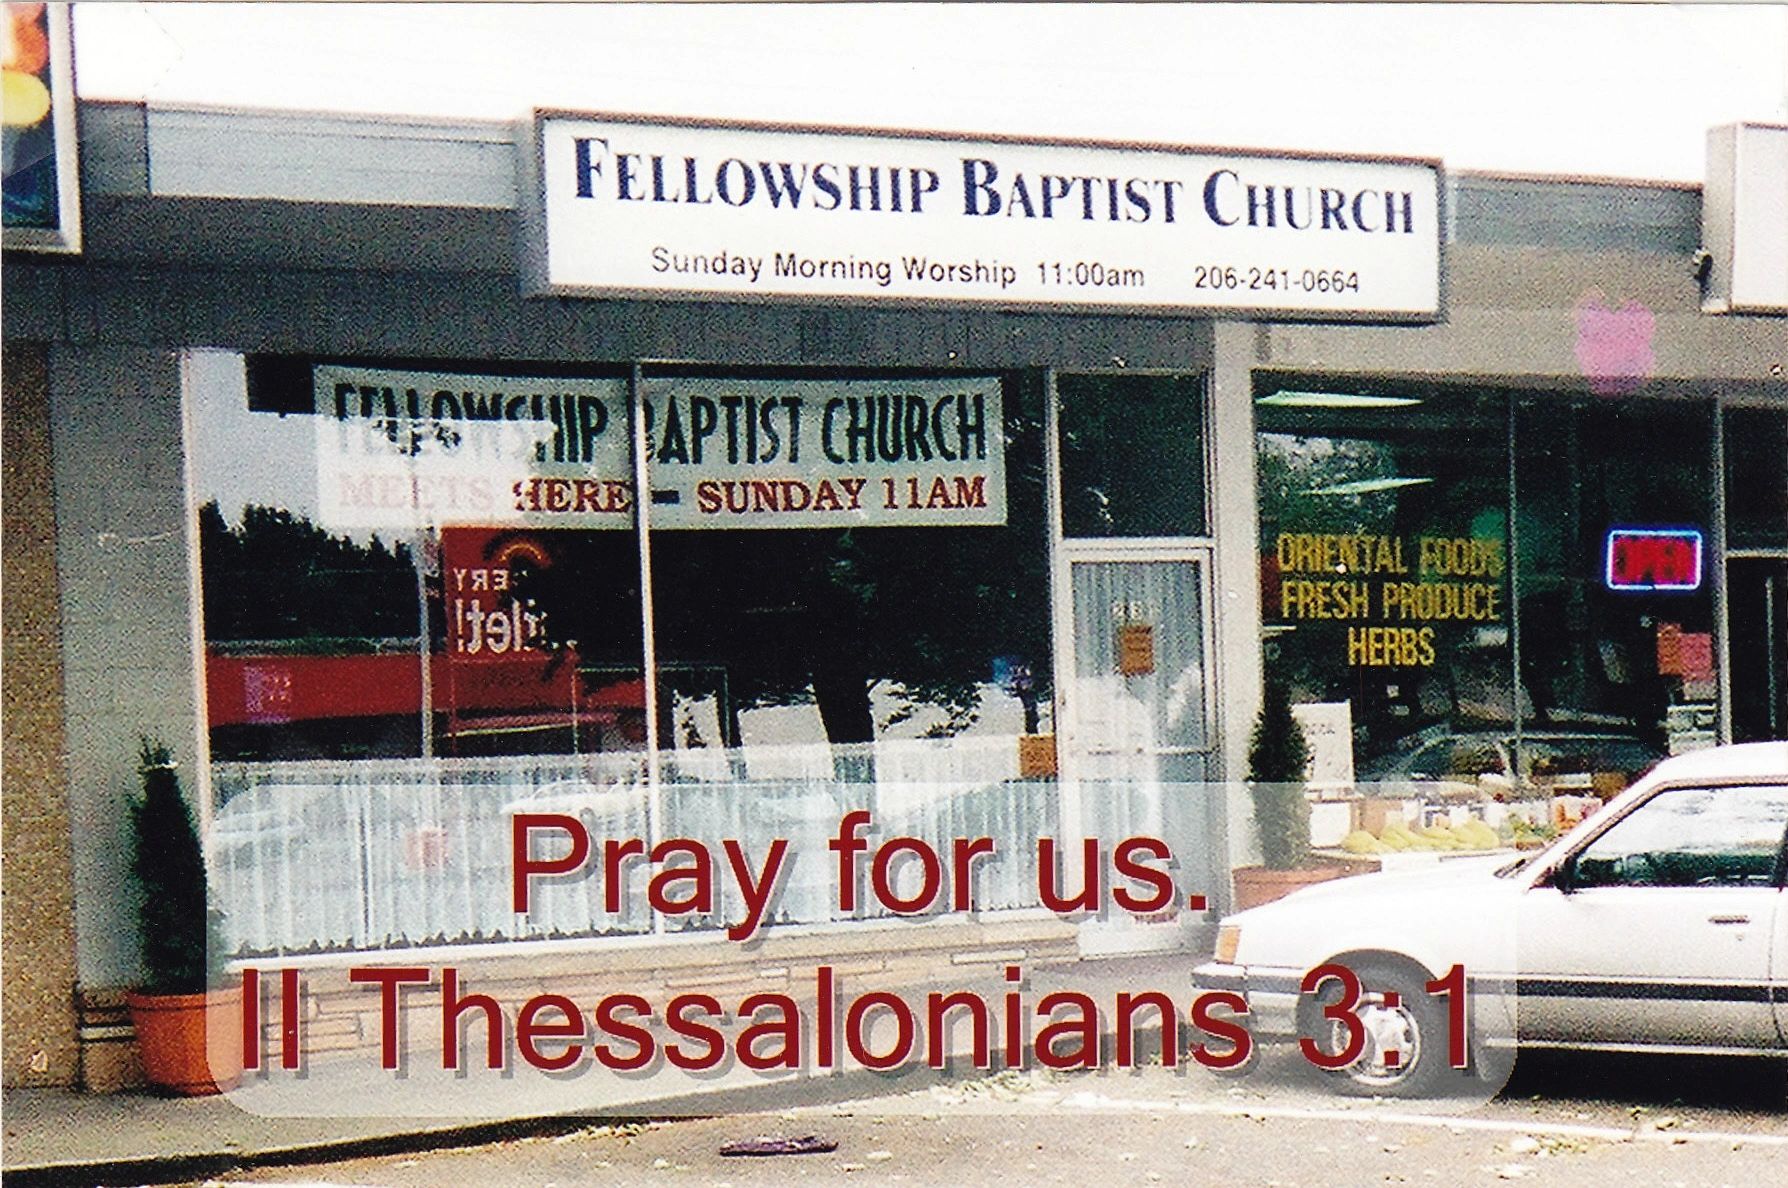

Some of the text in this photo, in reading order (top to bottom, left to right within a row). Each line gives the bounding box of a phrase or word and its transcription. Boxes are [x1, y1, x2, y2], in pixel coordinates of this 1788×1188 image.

[574, 136, 1414, 233] FELLOWSHIP BAPTIST CHURCH
[651, 246, 1361, 294] Sunday Morning Worship 11:00am 206-241-0664
[822, 393, 986, 463] CHURCH
[512, 478, 633, 514] HERE
[697, 478, 868, 514] SUNDAY
[882, 475, 988, 510] 11AM
[1276, 532, 1408, 574] ORIENTAL
[1281, 581, 1501, 620] FRESH PRODUCE
[1347, 626, 1436, 667] HERBS
